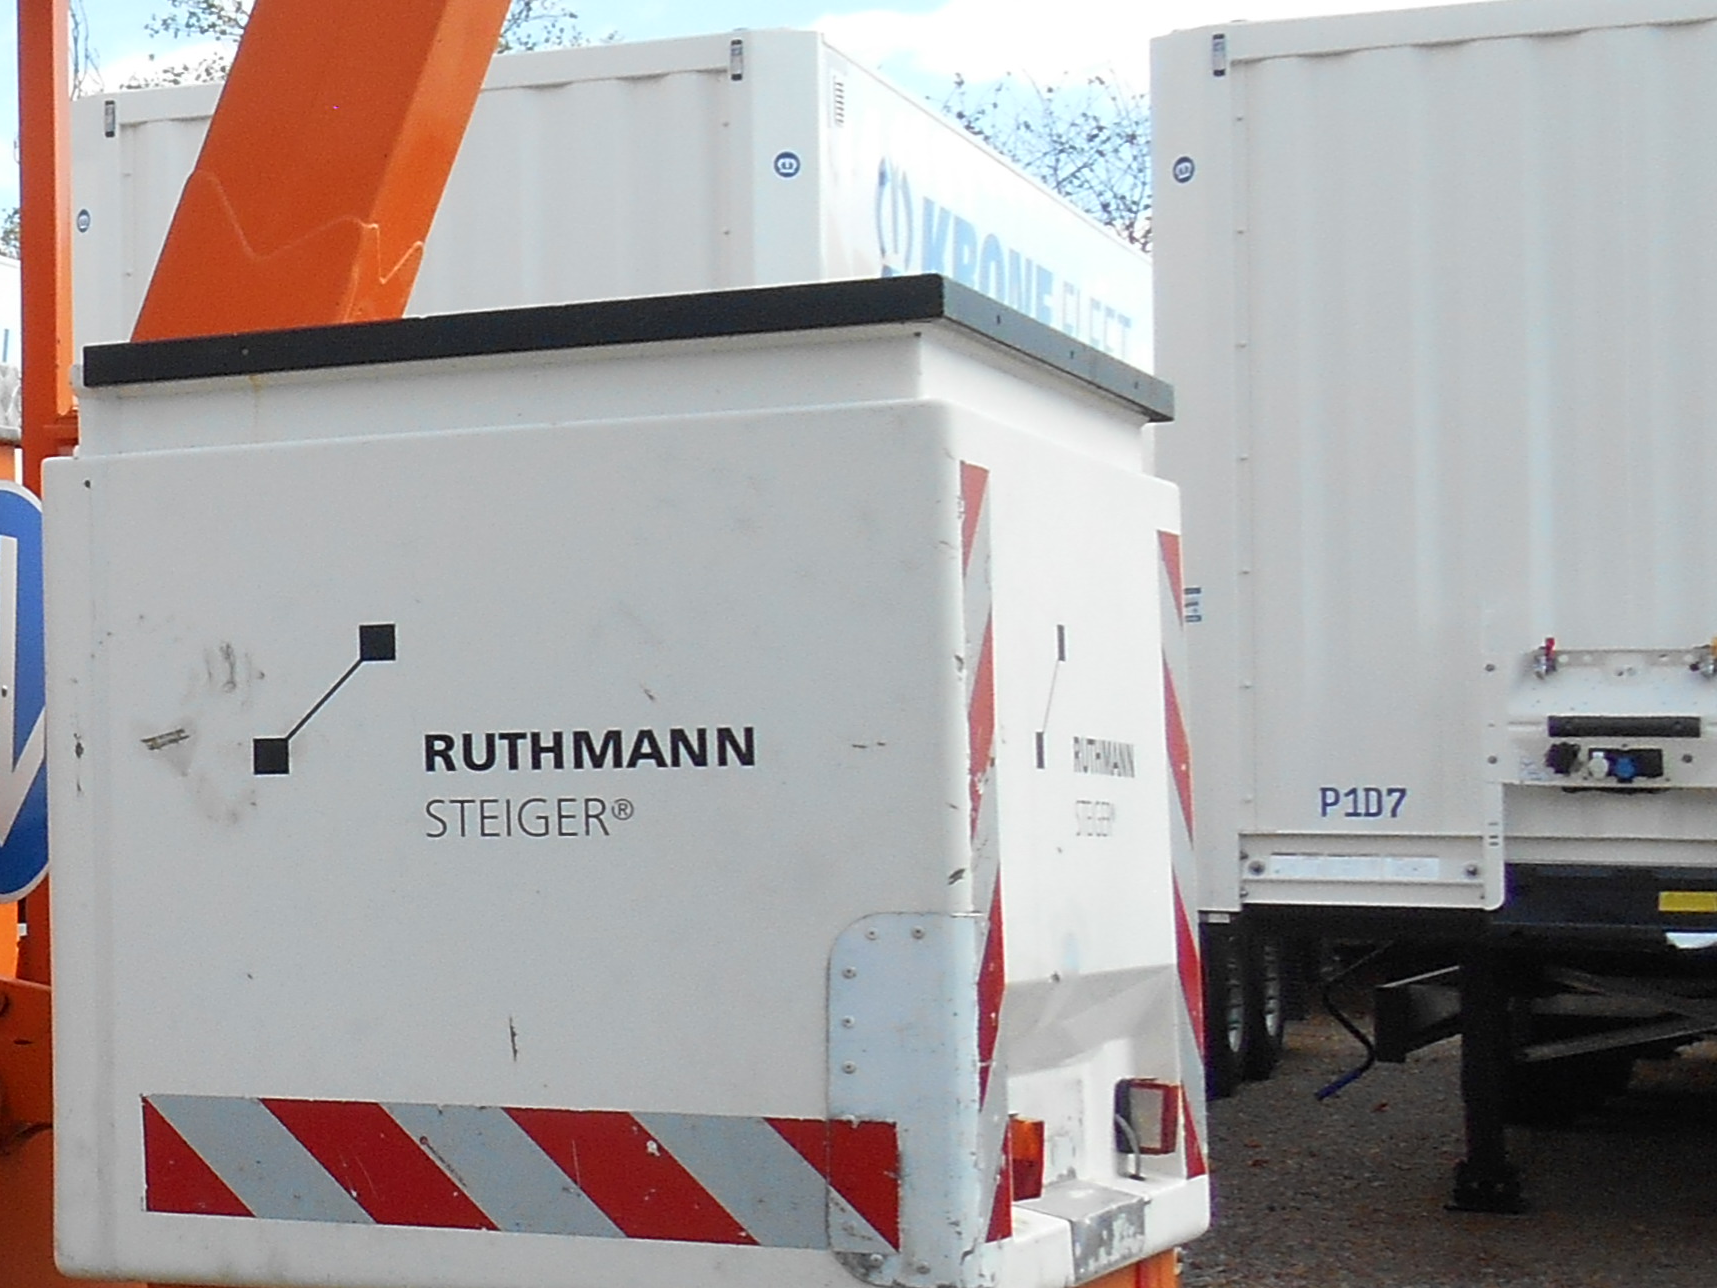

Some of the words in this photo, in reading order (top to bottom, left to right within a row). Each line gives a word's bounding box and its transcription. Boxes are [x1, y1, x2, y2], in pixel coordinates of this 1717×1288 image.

[424, 726, 756, 772] RUTHMANN
[1073, 736, 1135, 778] RUTHMANN
[425, 797, 635, 839] STEIGER®
[1319, 786, 1408, 819] P1D7
